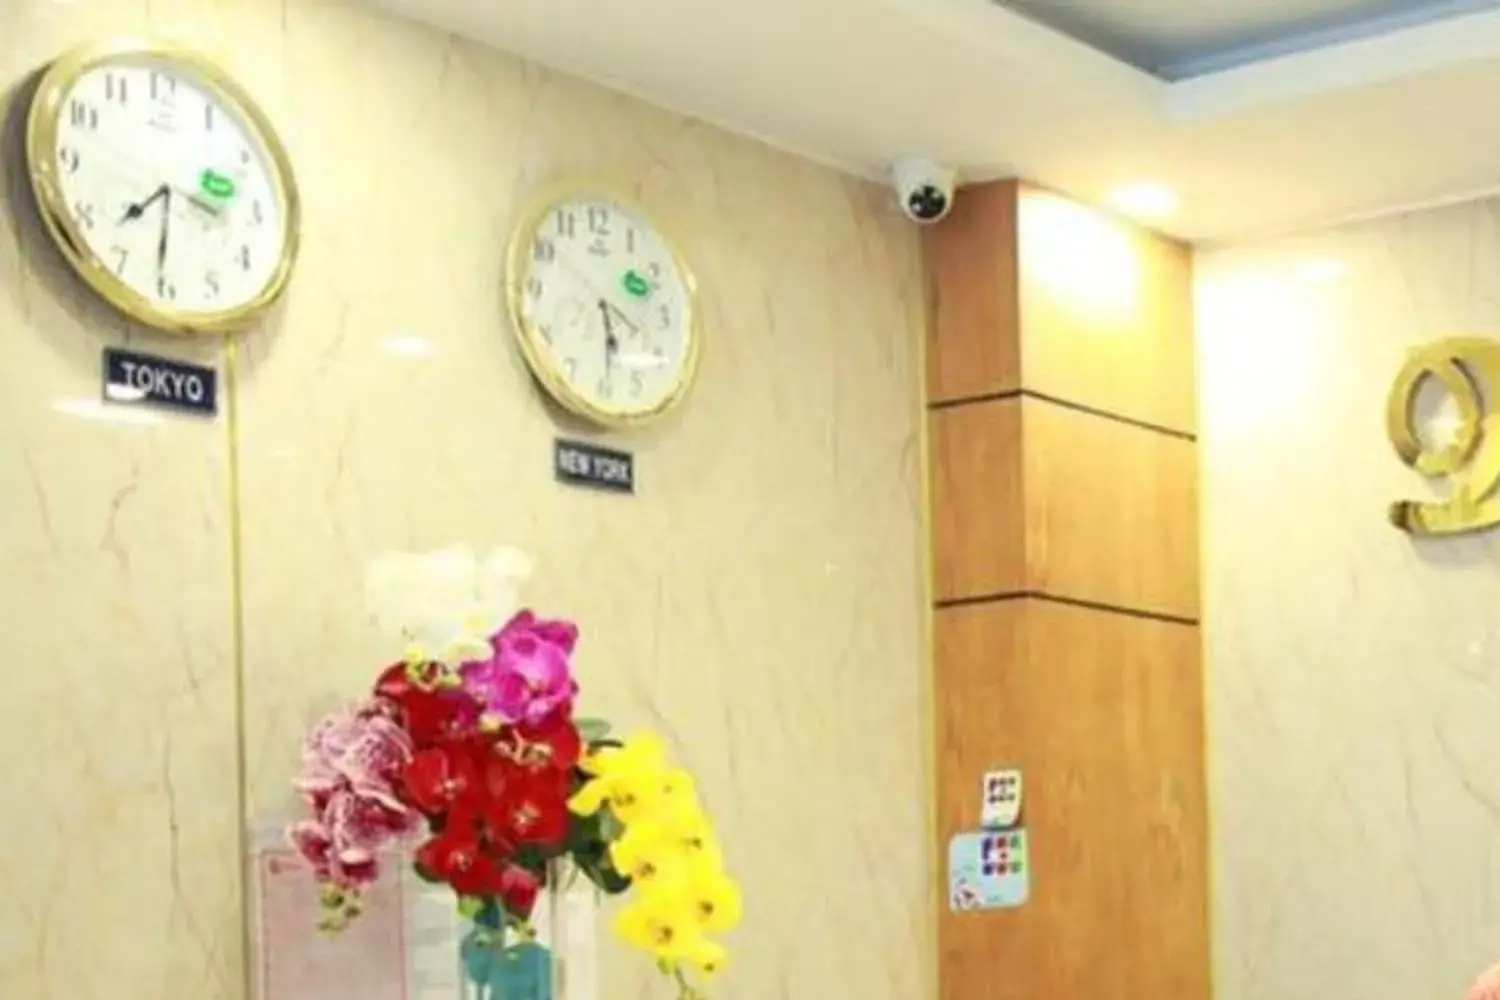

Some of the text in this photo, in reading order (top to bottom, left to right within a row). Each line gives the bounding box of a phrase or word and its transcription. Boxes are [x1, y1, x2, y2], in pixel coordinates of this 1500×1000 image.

[104, 72, 127, 104] 11
[556, 208, 576, 240] 11
[587, 206, 611, 236] 12
[120, 361, 205, 404] TOKYO
